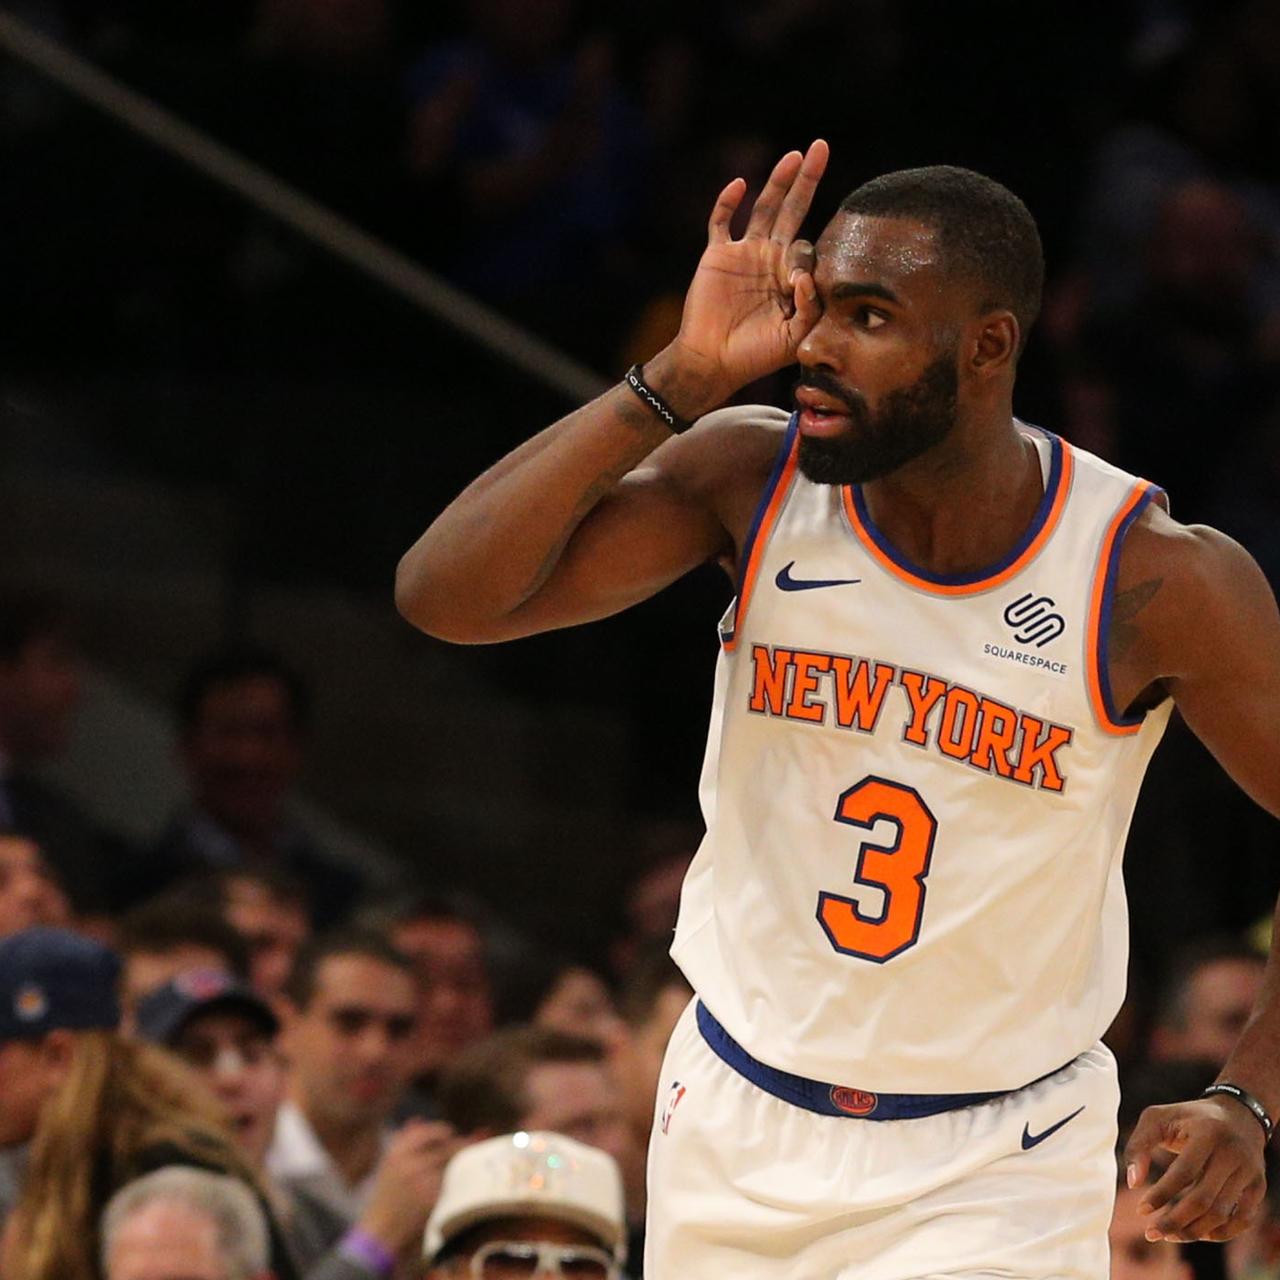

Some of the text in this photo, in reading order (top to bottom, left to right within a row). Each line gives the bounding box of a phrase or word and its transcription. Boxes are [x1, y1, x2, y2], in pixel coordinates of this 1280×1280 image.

[748, 642, 1073, 794] NEW YORK
[984, 644, 1067, 674] SQUARESPACE
[816, 775, 938, 964] 3
